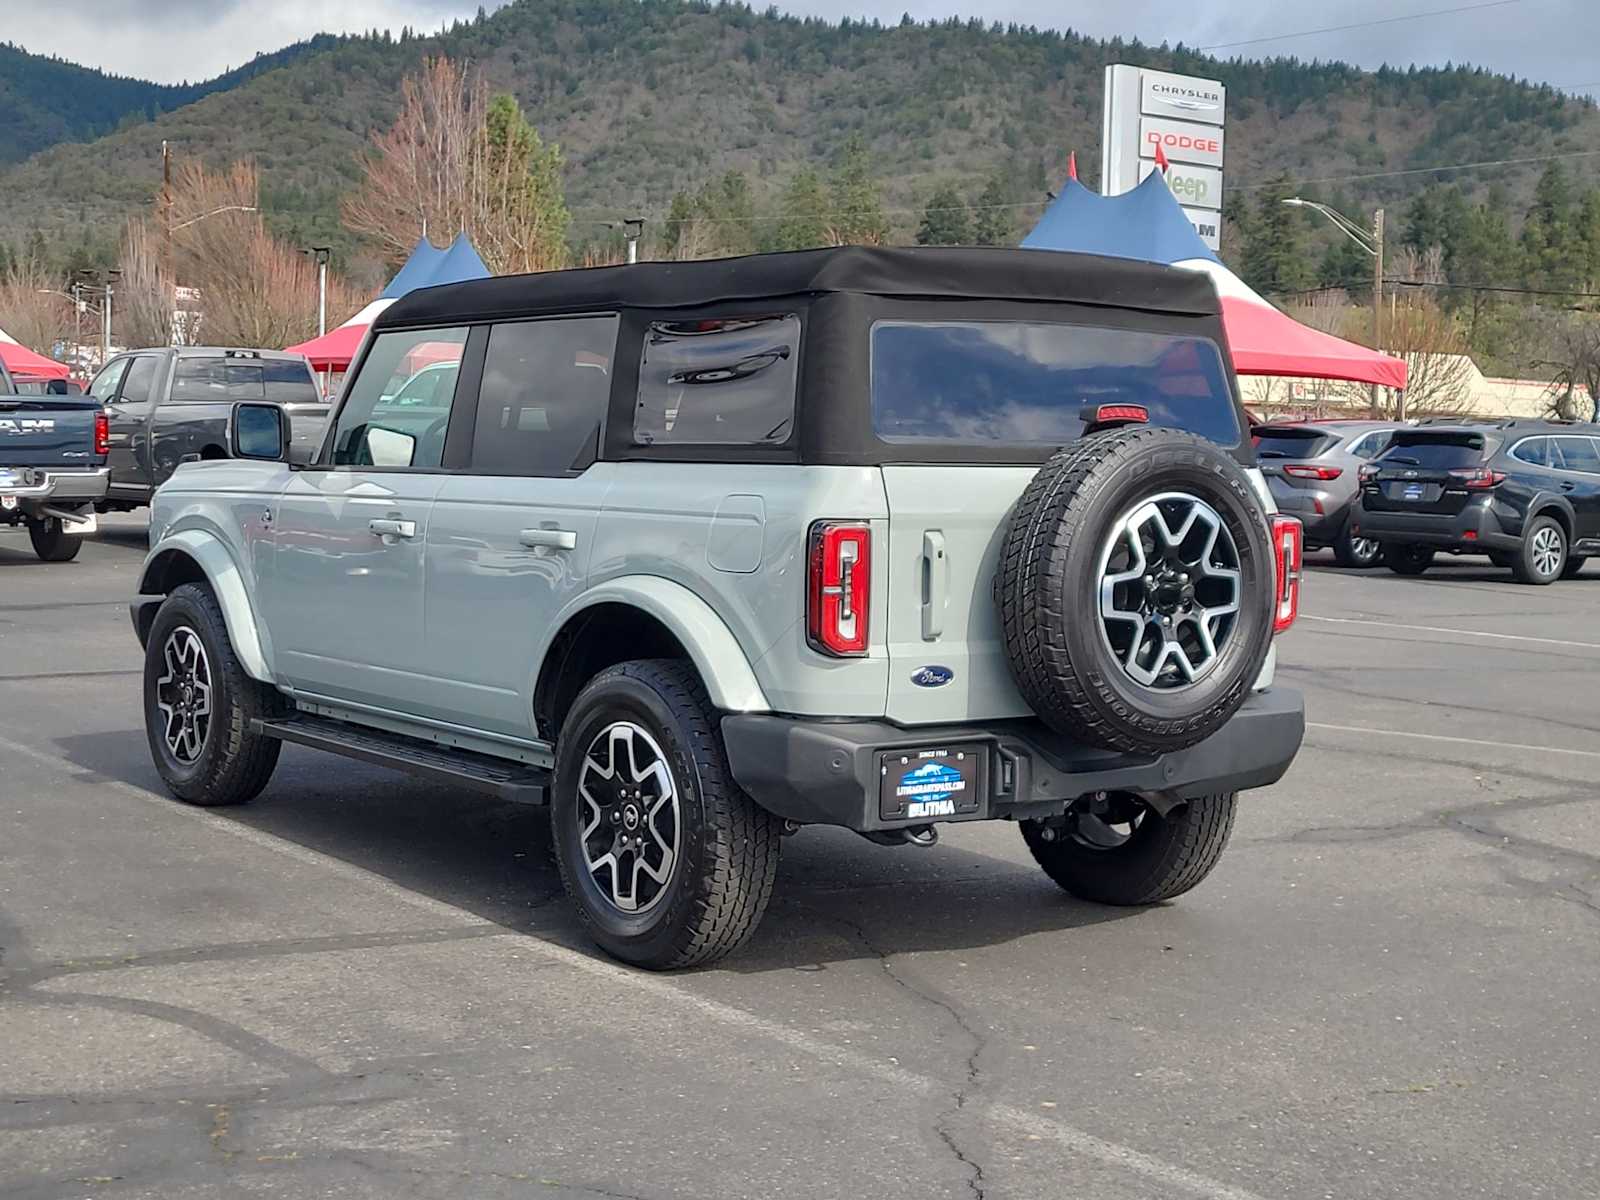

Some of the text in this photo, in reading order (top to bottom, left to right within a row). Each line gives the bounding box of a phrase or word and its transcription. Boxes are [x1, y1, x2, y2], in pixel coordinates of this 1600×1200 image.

[1152, 84, 1219, 101] CHRYSLER
[1147, 132, 1219, 152] DODGE
[0, 420, 55, 433] AM
